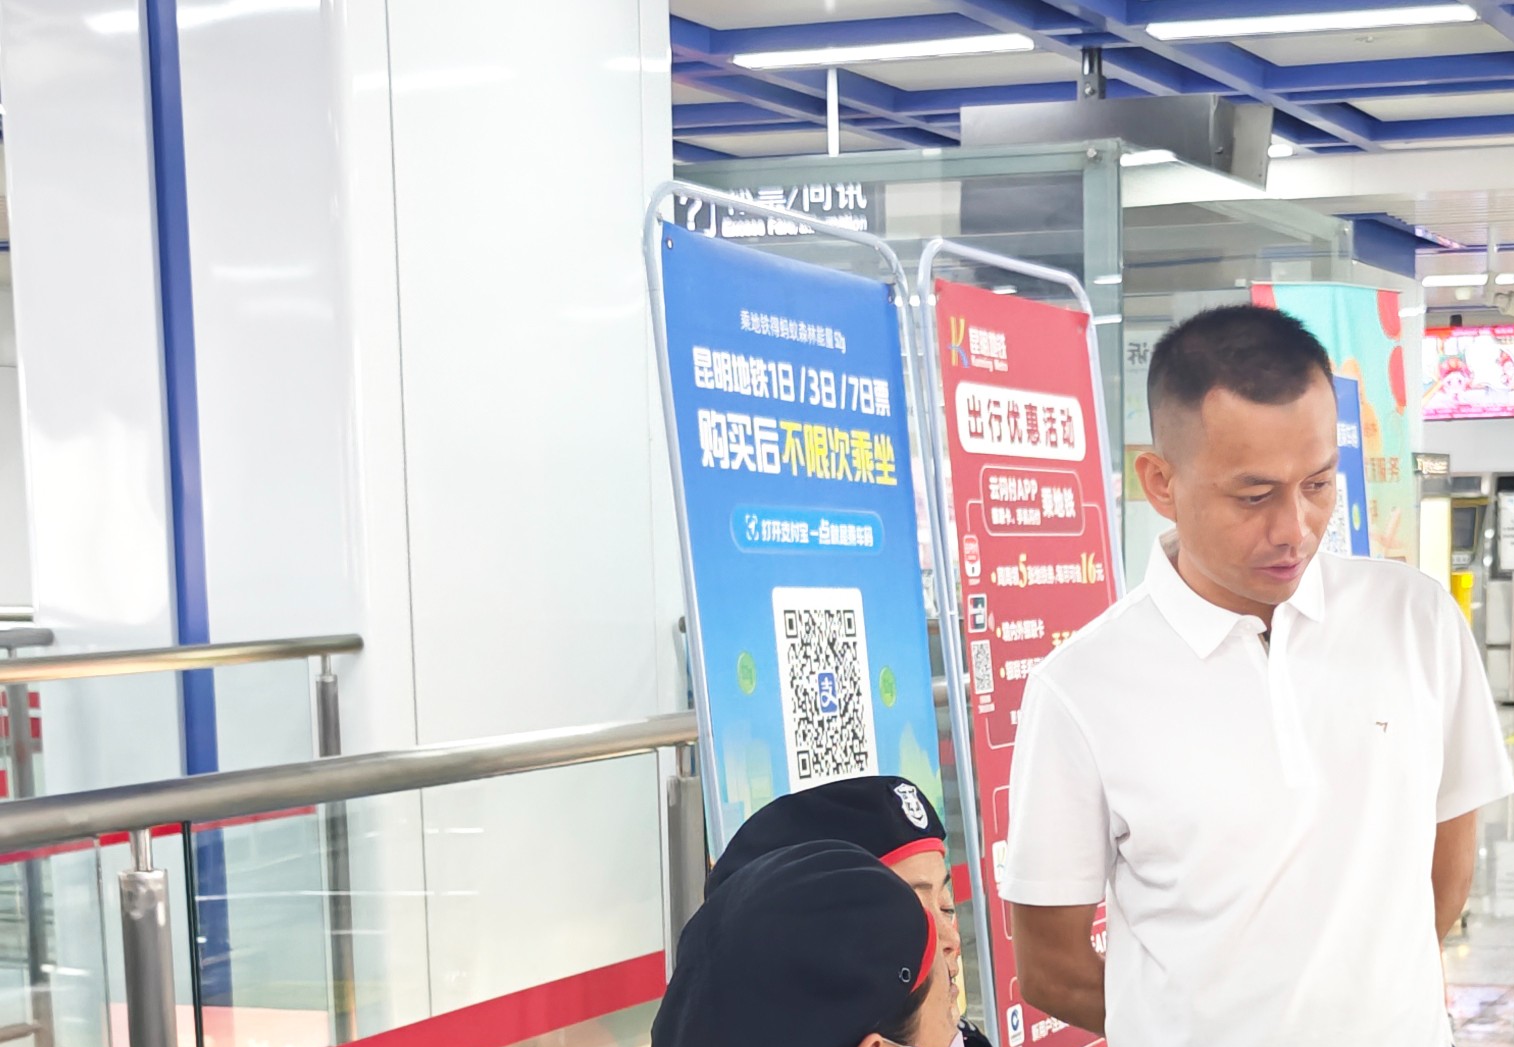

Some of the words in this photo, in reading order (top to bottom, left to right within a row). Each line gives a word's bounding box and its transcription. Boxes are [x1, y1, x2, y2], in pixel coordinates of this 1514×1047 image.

[698, 408, 897, 486] 购买后不限次乘坐
[966, 394, 1075, 448] 出行优惠活动
